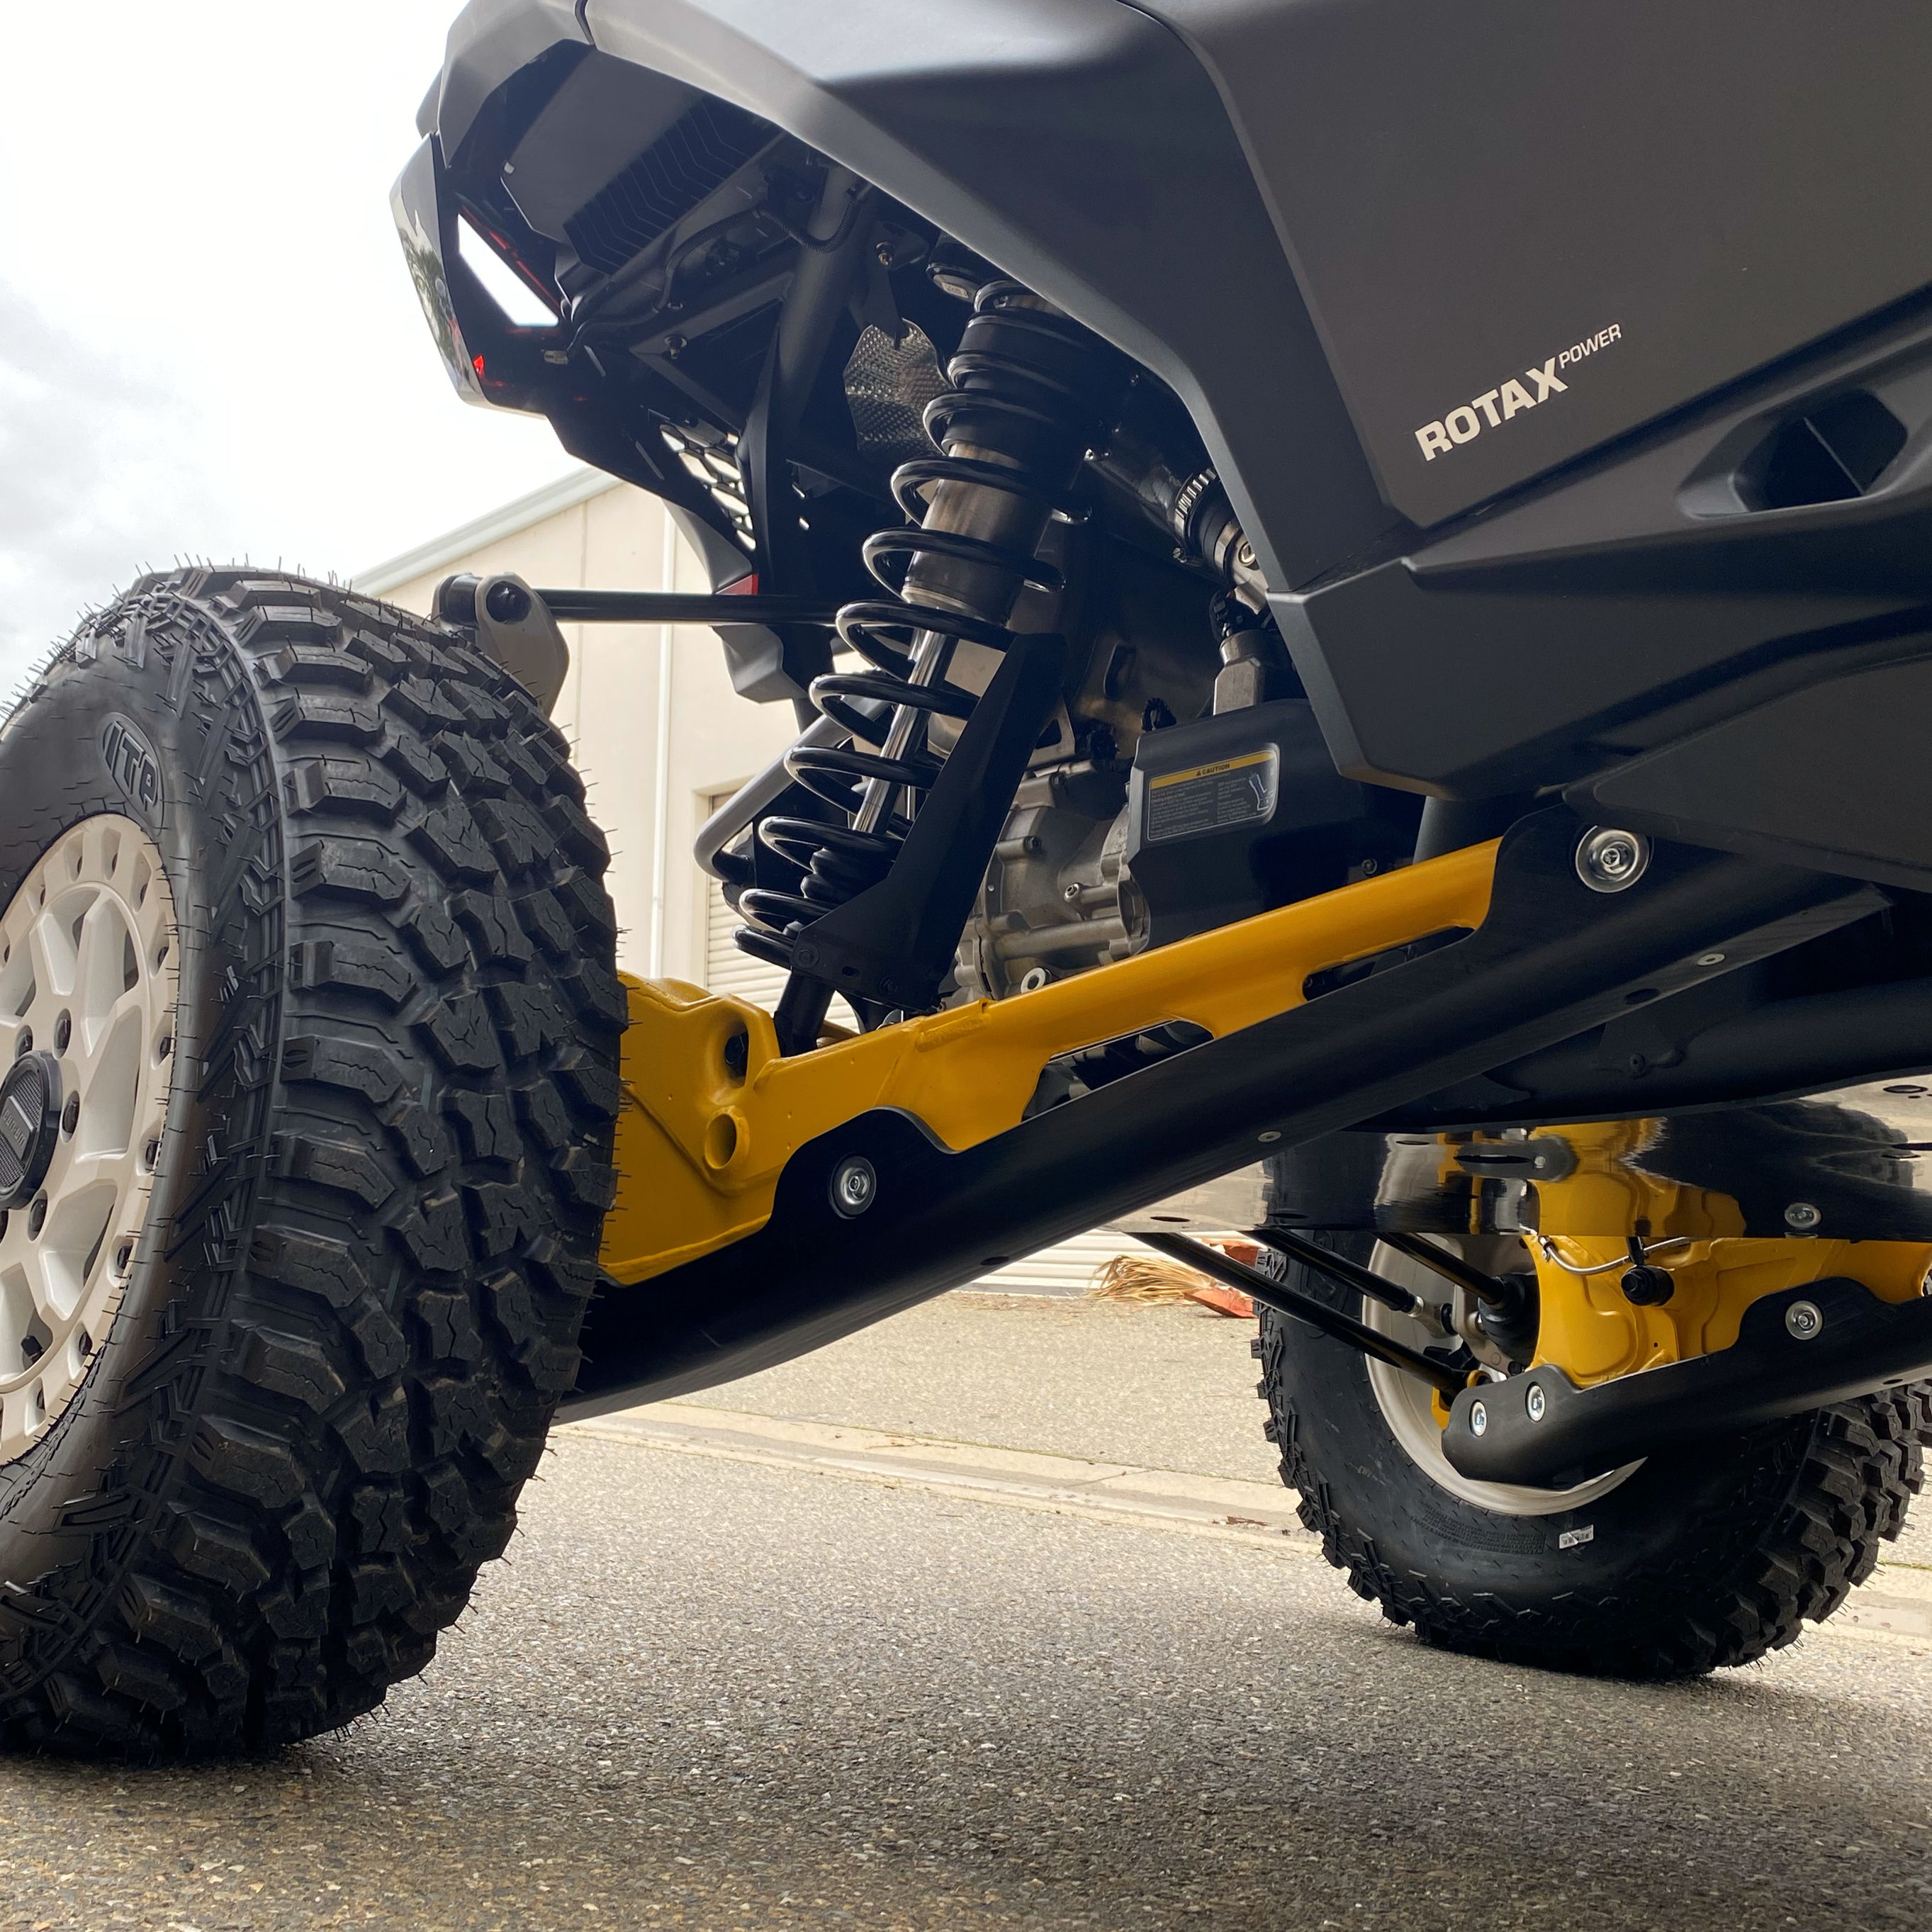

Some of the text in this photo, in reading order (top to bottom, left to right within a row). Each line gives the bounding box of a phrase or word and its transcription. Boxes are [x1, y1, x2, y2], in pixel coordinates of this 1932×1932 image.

[1415, 322, 1622, 461] ROTAX POWER
[105, 721, 159, 811] ITP
[1202, 763, 1230, 775] CAUTION
